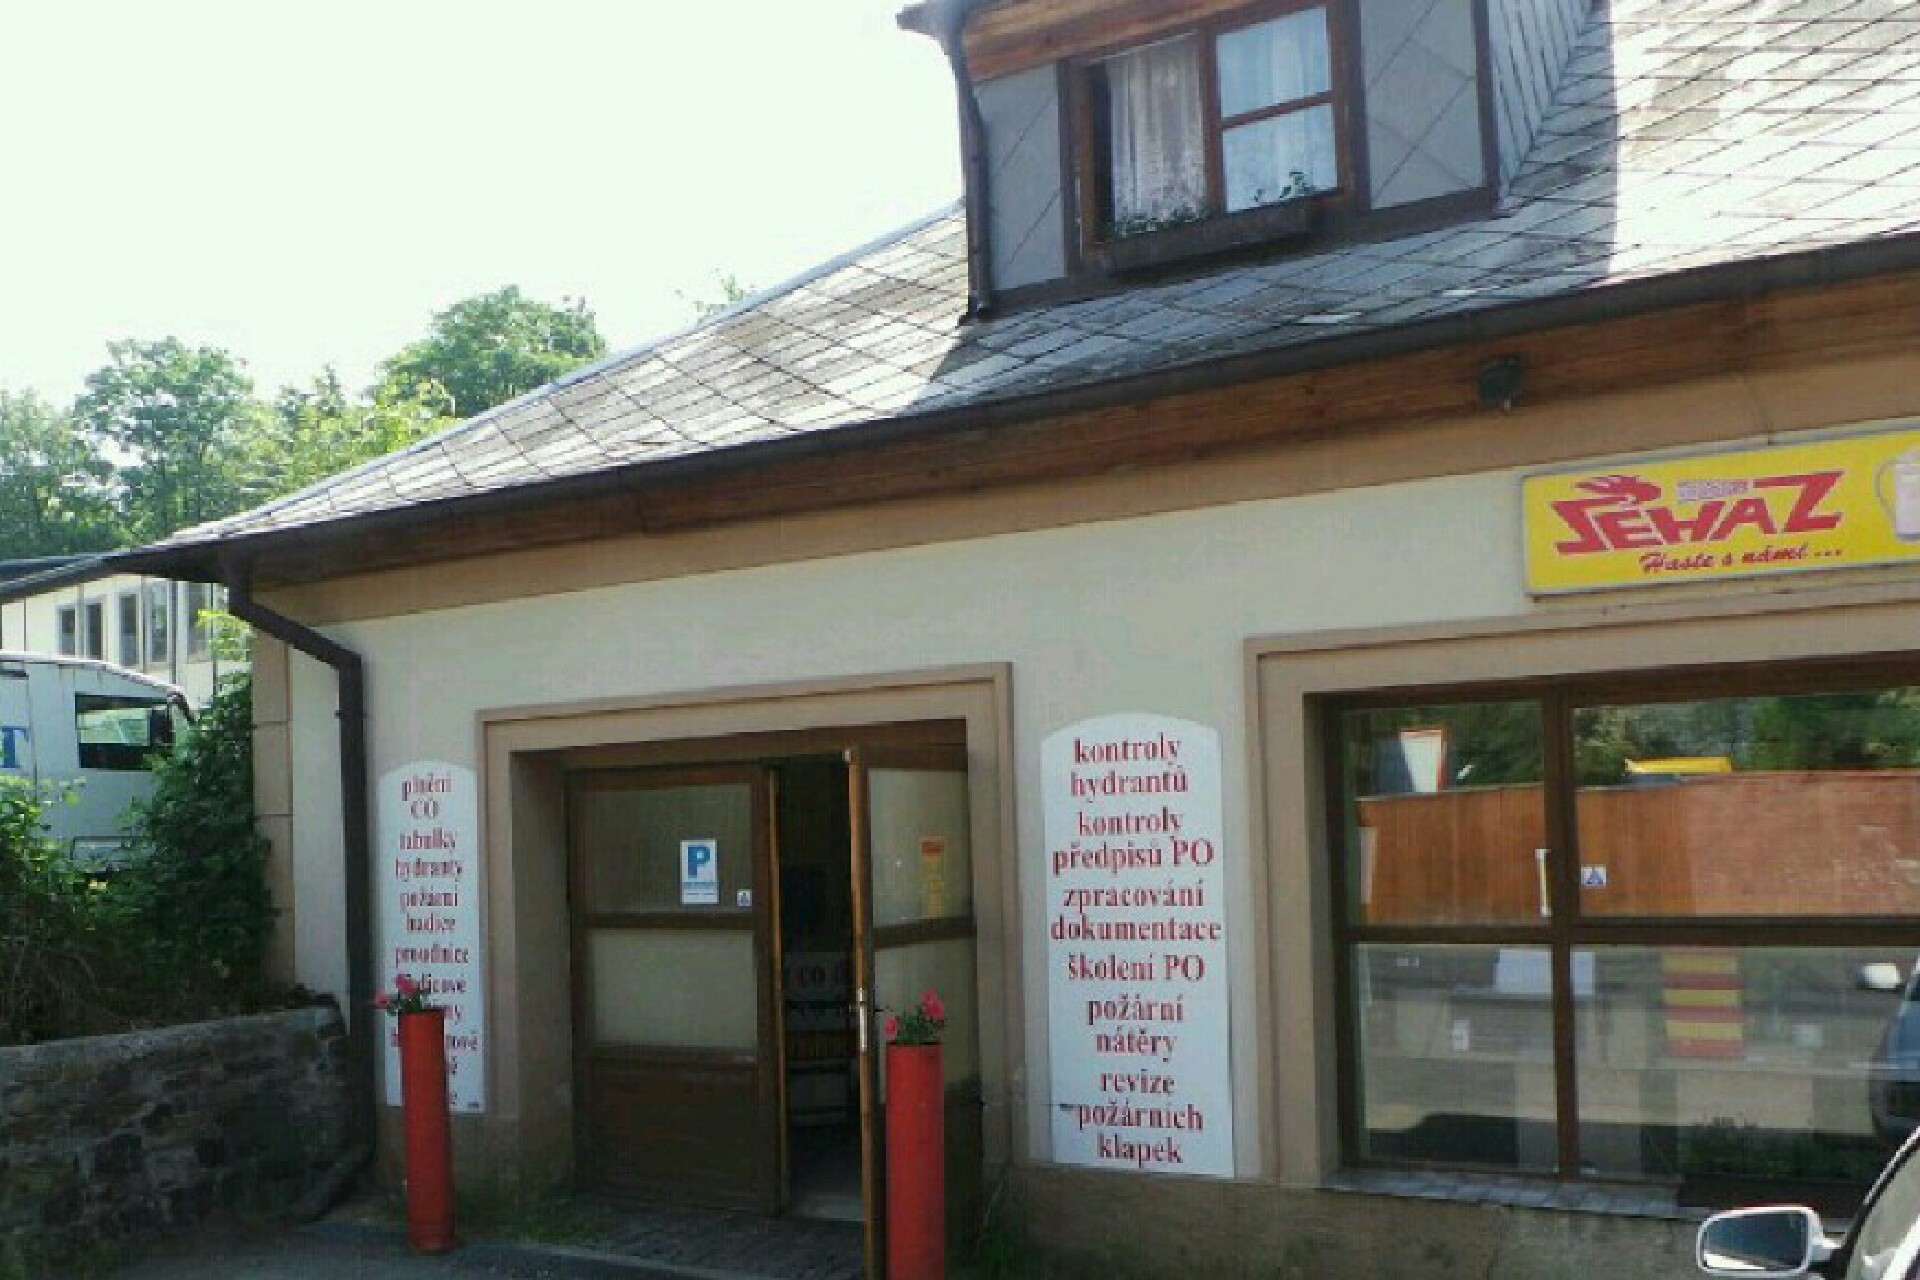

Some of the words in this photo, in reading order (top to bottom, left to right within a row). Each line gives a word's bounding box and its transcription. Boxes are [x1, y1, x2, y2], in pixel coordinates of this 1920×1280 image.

[1073, 733, 1182, 765] kontroly
[1070, 766, 1189, 802] hydrantů
[1078, 807, 1184, 839] kontroly
[687, 845, 711, 879] P
[1052, 840, 1163, 876] předpisů
[1172, 837, 1215, 867] PO
[1063, 879, 1205, 914] zpracování
[1050, 913, 1223, 943] dokumentace
[1068, 954, 1154, 983] školení
[1164, 954, 1206, 983] PO
[1087, 994, 1185, 1026] požární
[1096, 1026, 1177, 1062] nátěry
[1100, 1068, 1176, 1094] revize
[1075, 1101, 1205, 1133] požárních
[1097, 1132, 1184, 1169] klapek
